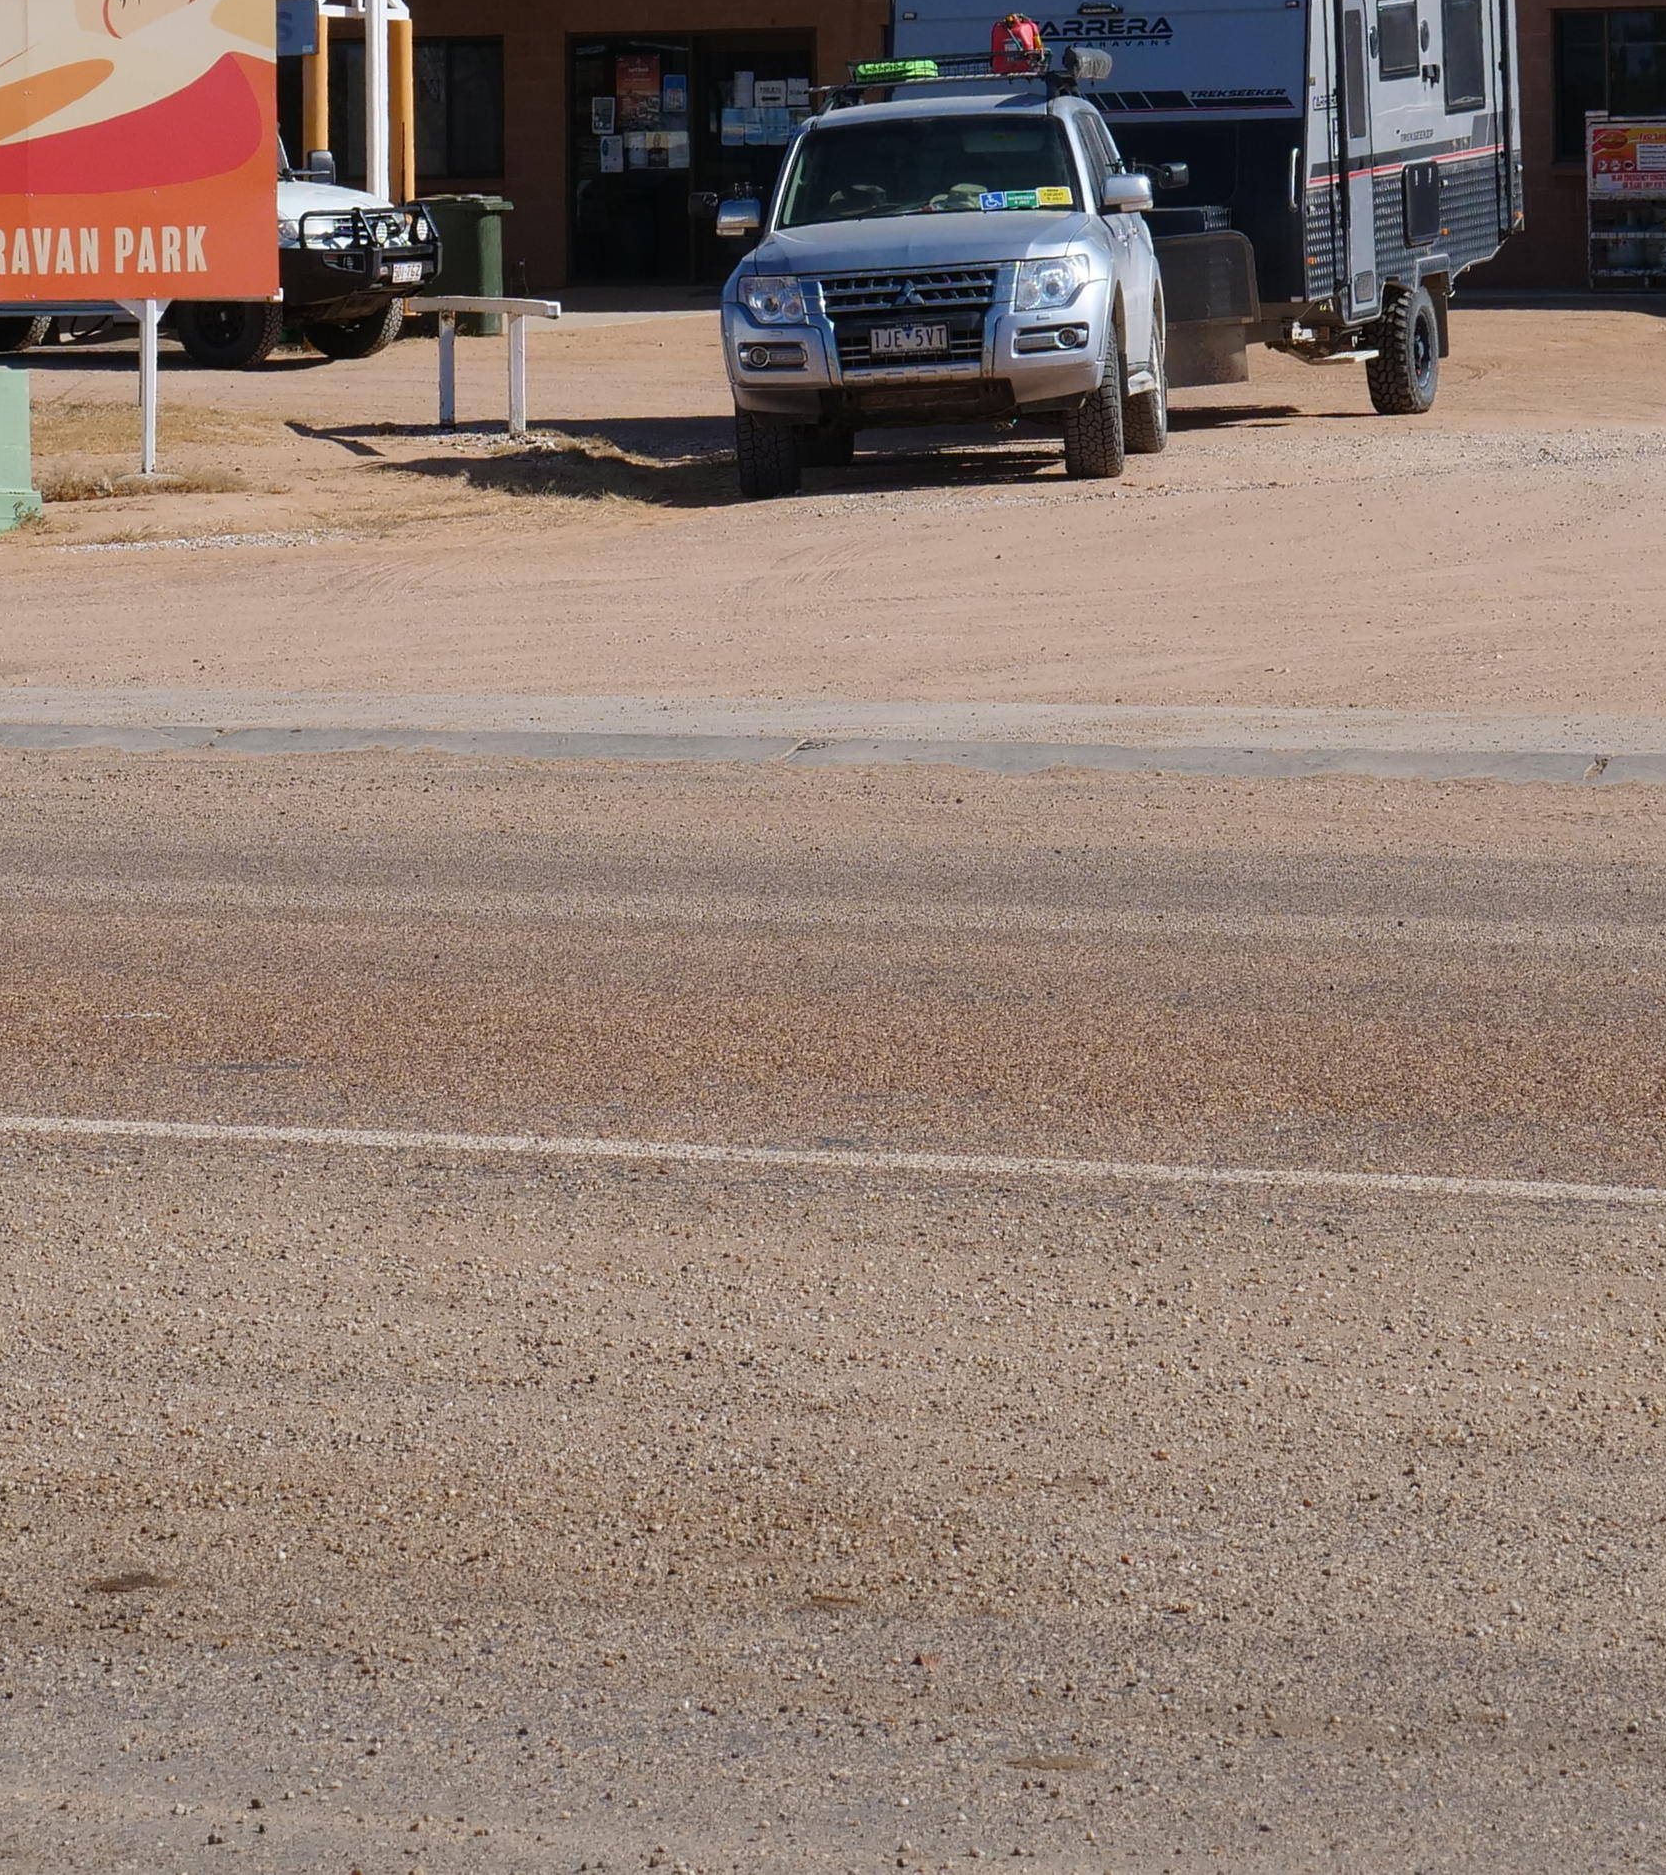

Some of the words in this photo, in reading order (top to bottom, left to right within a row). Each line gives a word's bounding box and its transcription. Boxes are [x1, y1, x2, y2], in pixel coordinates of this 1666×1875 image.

[1035, 17, 1173, 37] ARRERA
[1073, 40, 1173, 48] CARAVANS
[1190, 88, 1286, 98] TREKSEEKER
[114, 225, 208, 274] PARK
